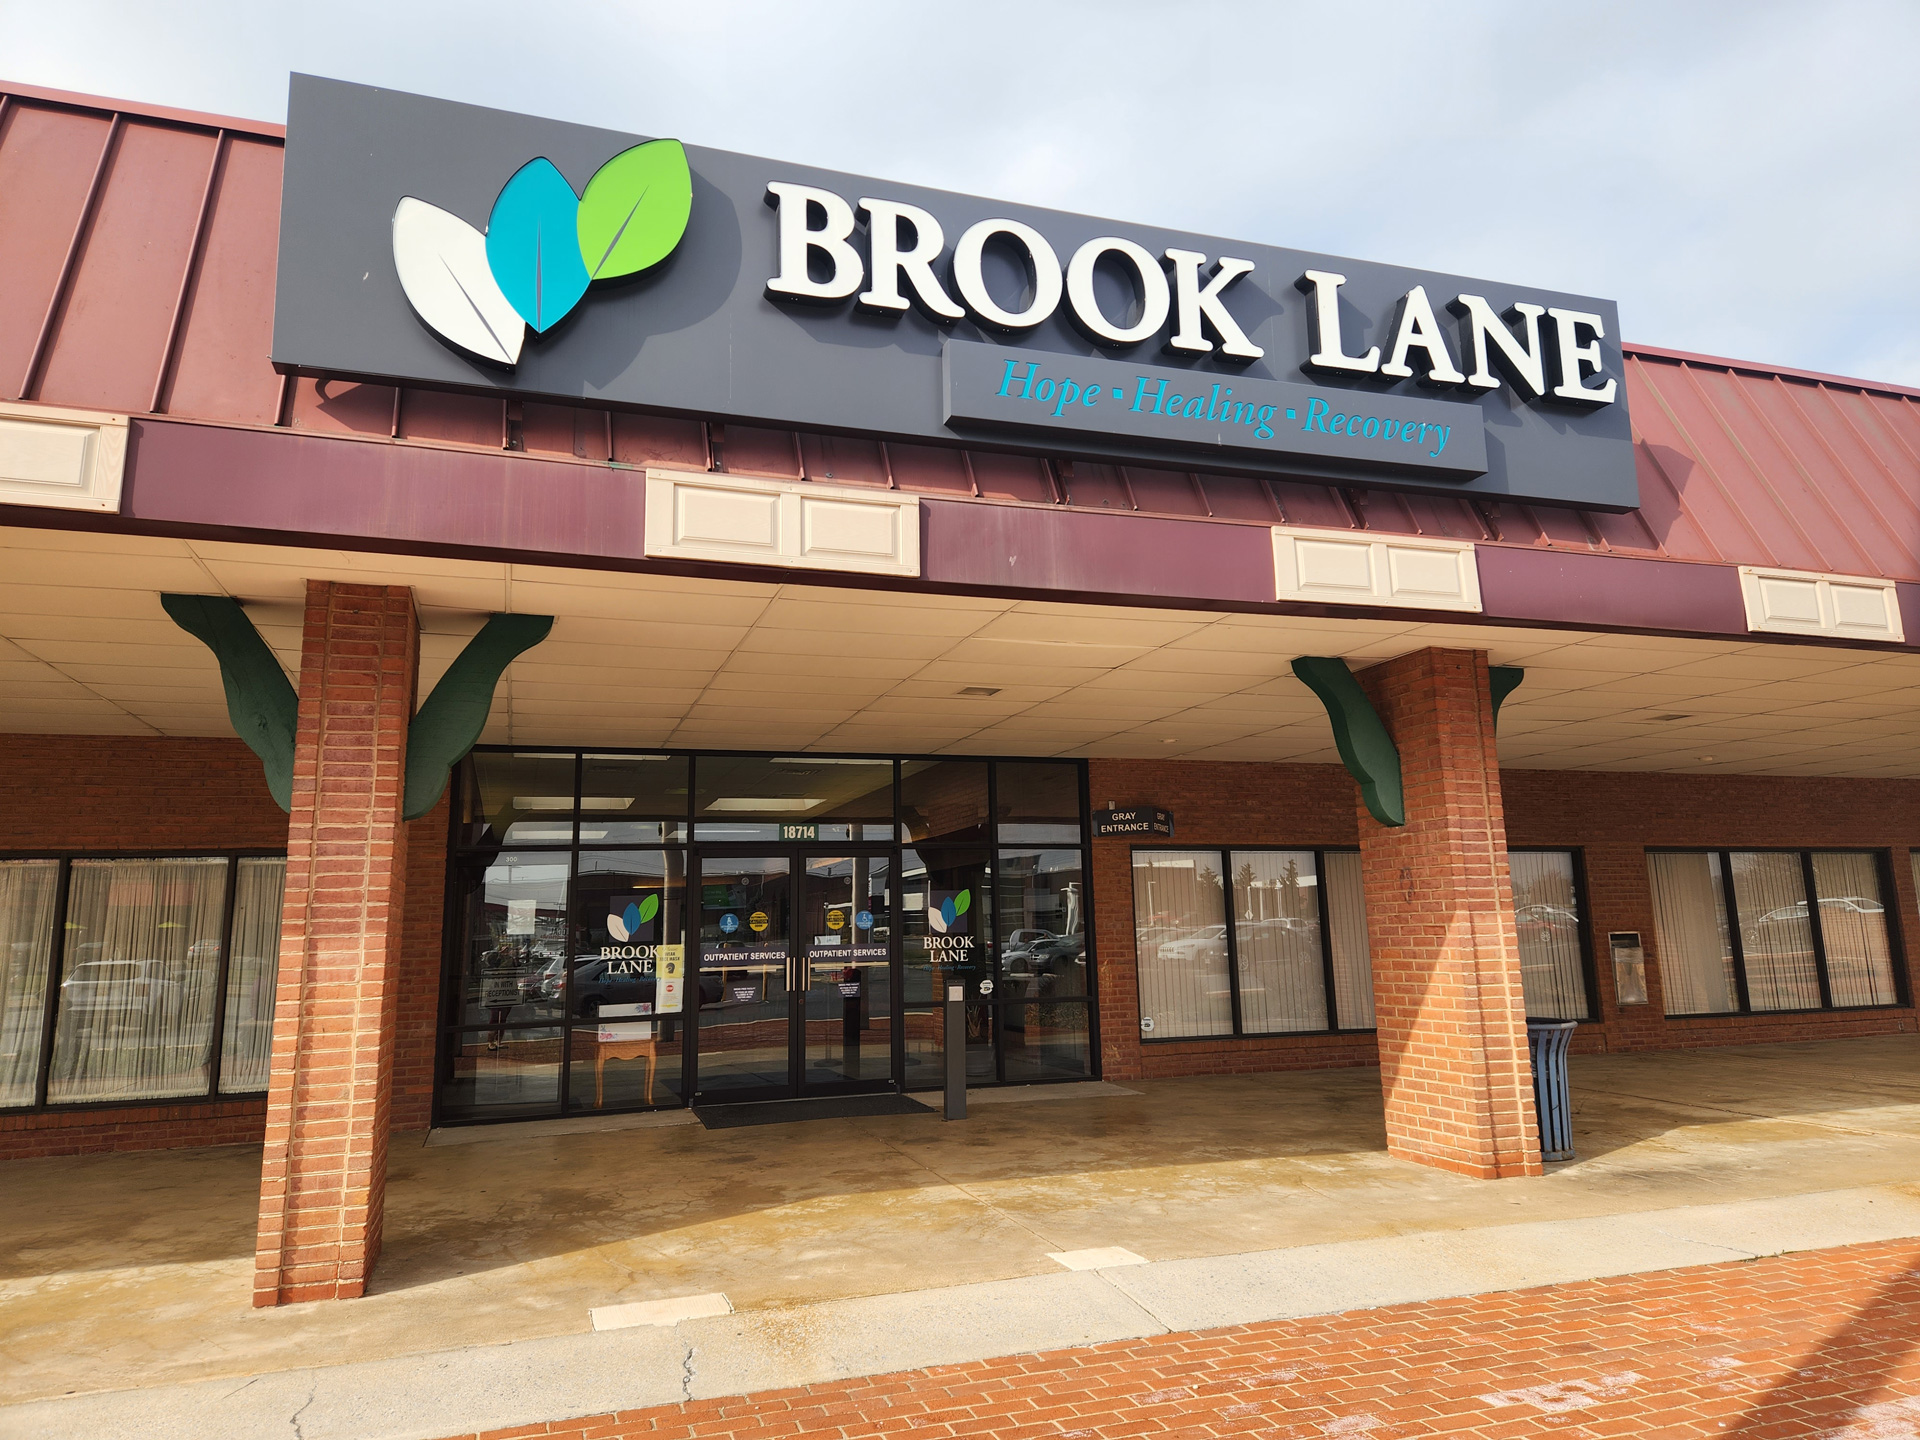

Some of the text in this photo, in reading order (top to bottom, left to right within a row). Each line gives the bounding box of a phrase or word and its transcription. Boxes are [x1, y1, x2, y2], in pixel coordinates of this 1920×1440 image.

[766, 180, 1618, 405] BROOK LANE
[996, 359, 1451, 457] Hope Healing Recovery
[1112, 812, 1136, 821] GRAY
[783, 826, 815, 839] 18714
[1101, 823, 1149, 833] ENTRANCE
[923, 935, 975, 949] BROOK
[600, 945, 660, 960] BROOK
[704, 951, 786, 961] OUTPATIENT SERVICES
[809, 948, 887, 958] OUTPATIENT SERVICES
[929, 949, 969, 963] LANE
[607, 960, 654, 975] LANE
